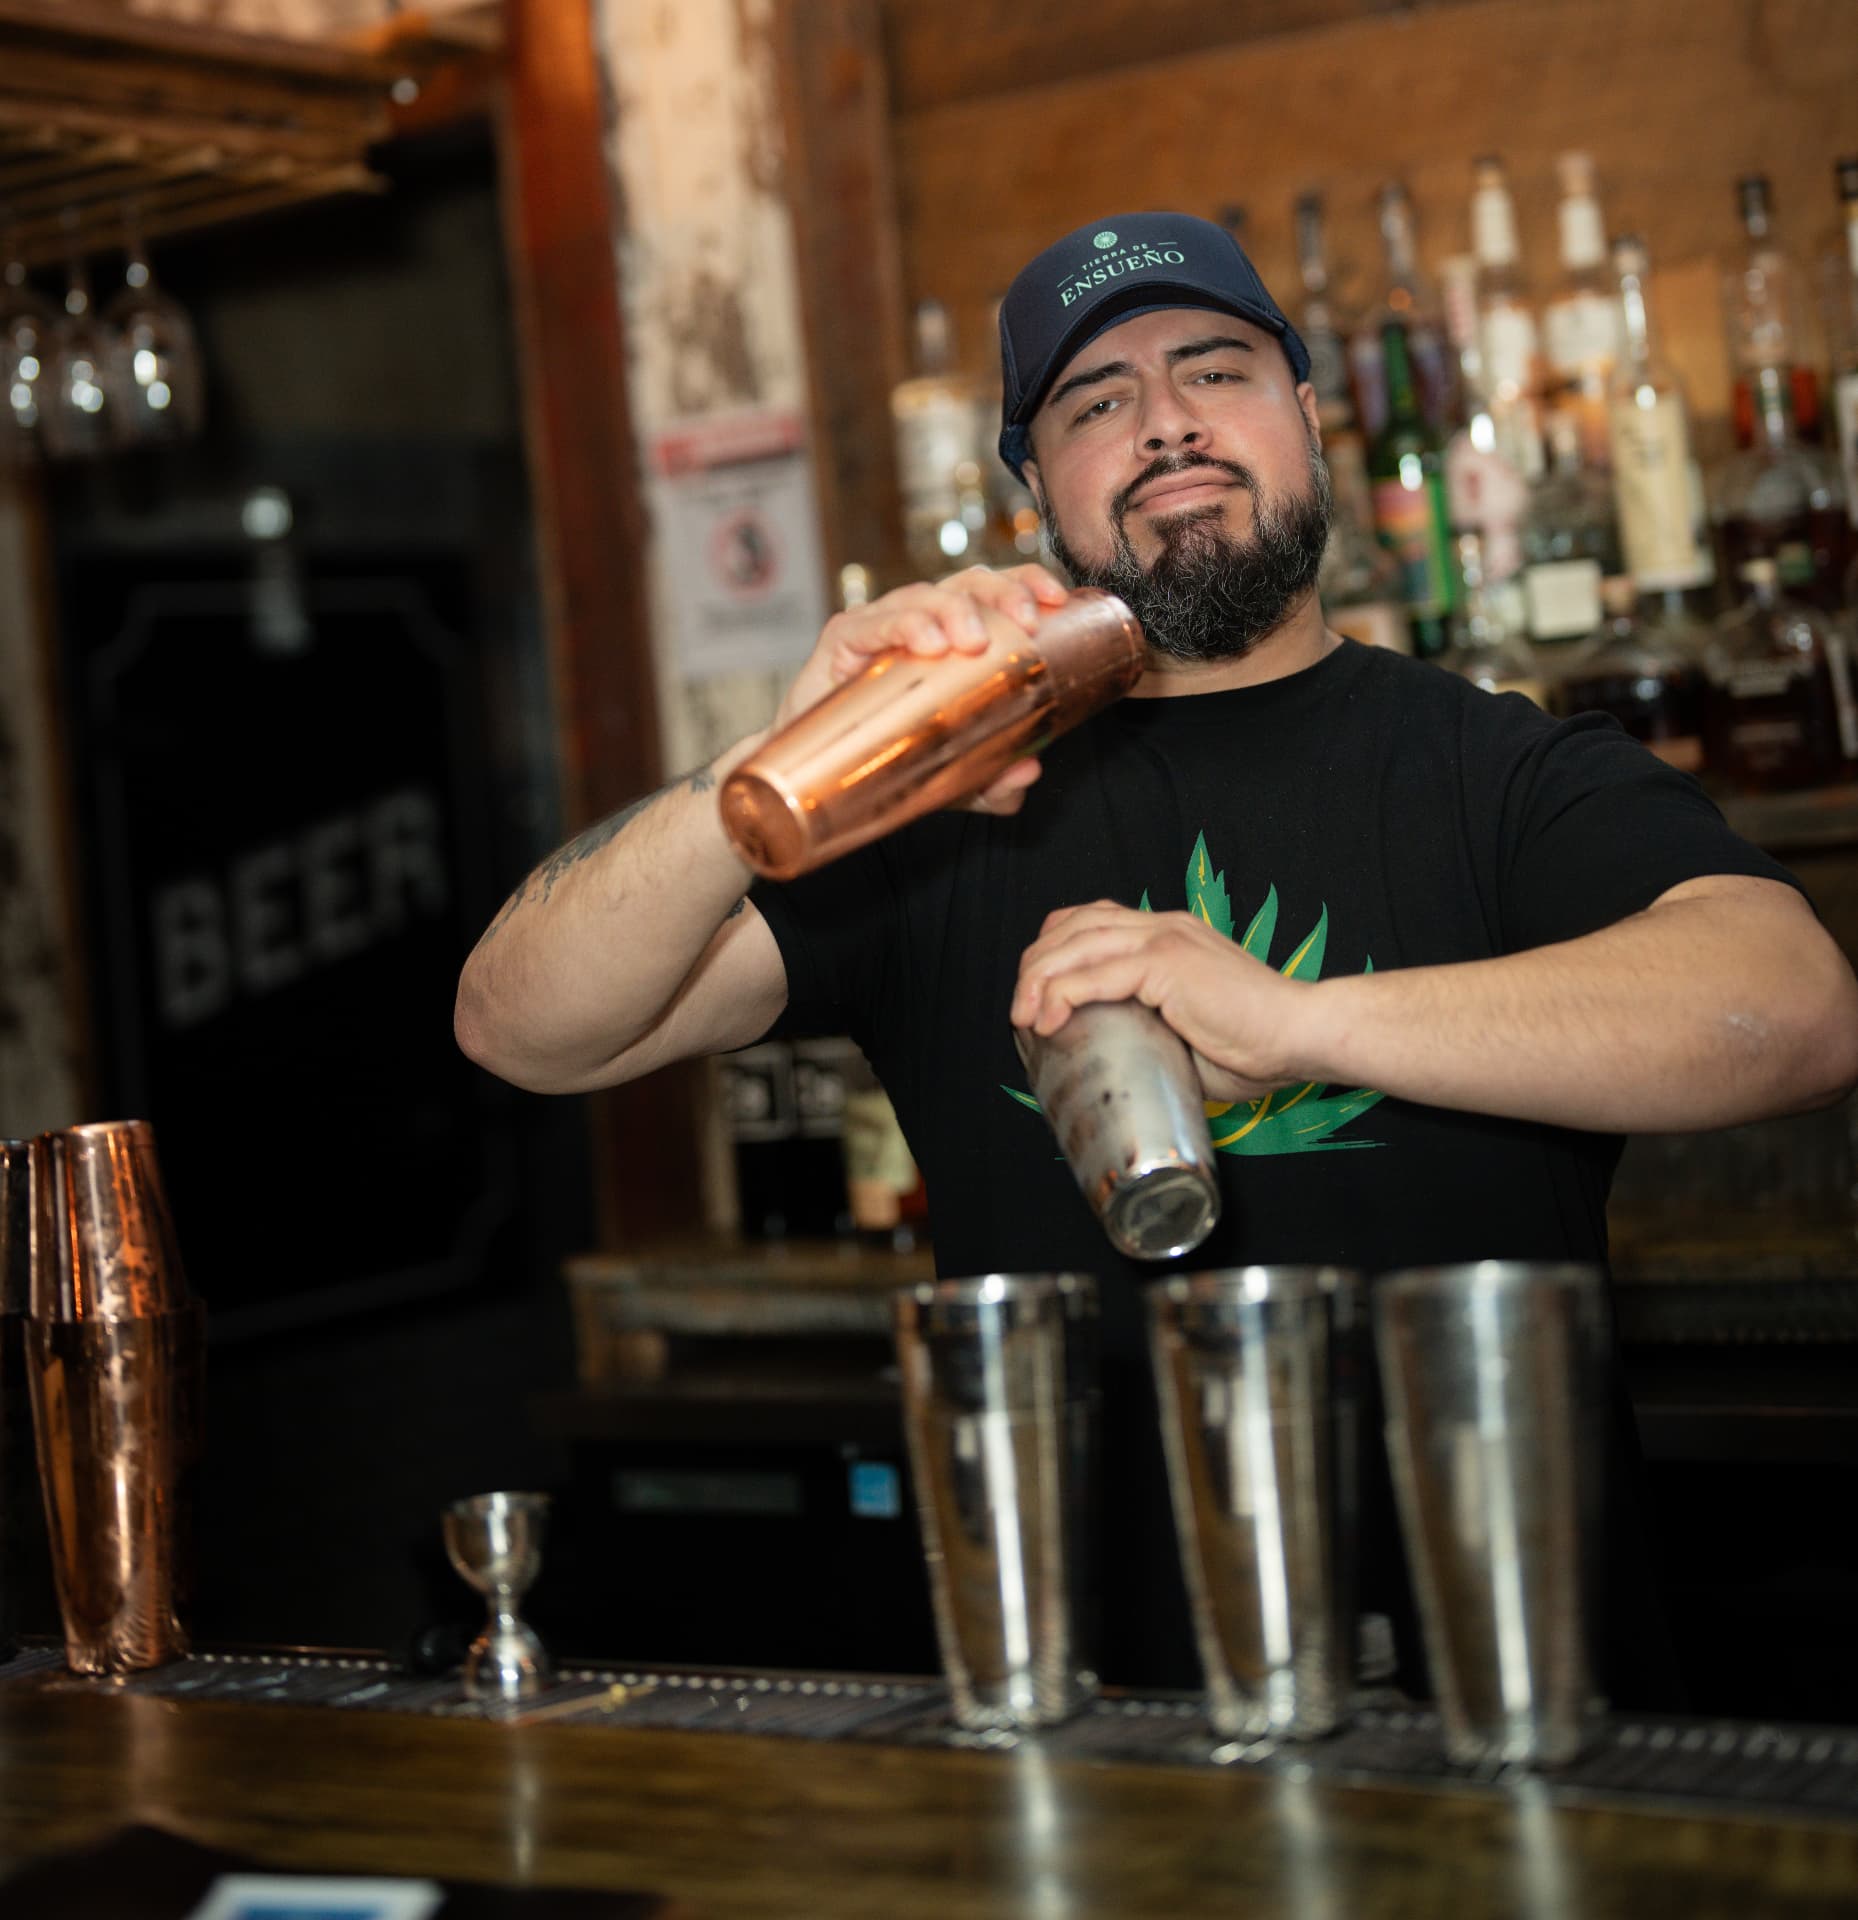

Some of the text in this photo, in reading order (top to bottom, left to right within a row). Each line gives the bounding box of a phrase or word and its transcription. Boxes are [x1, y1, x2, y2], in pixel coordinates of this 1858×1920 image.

[1060, 250, 1185, 307] ENSUEÑO
[1081, 243, 1149, 271] TIERRA DE
[154, 789, 446, 1024] BEER
